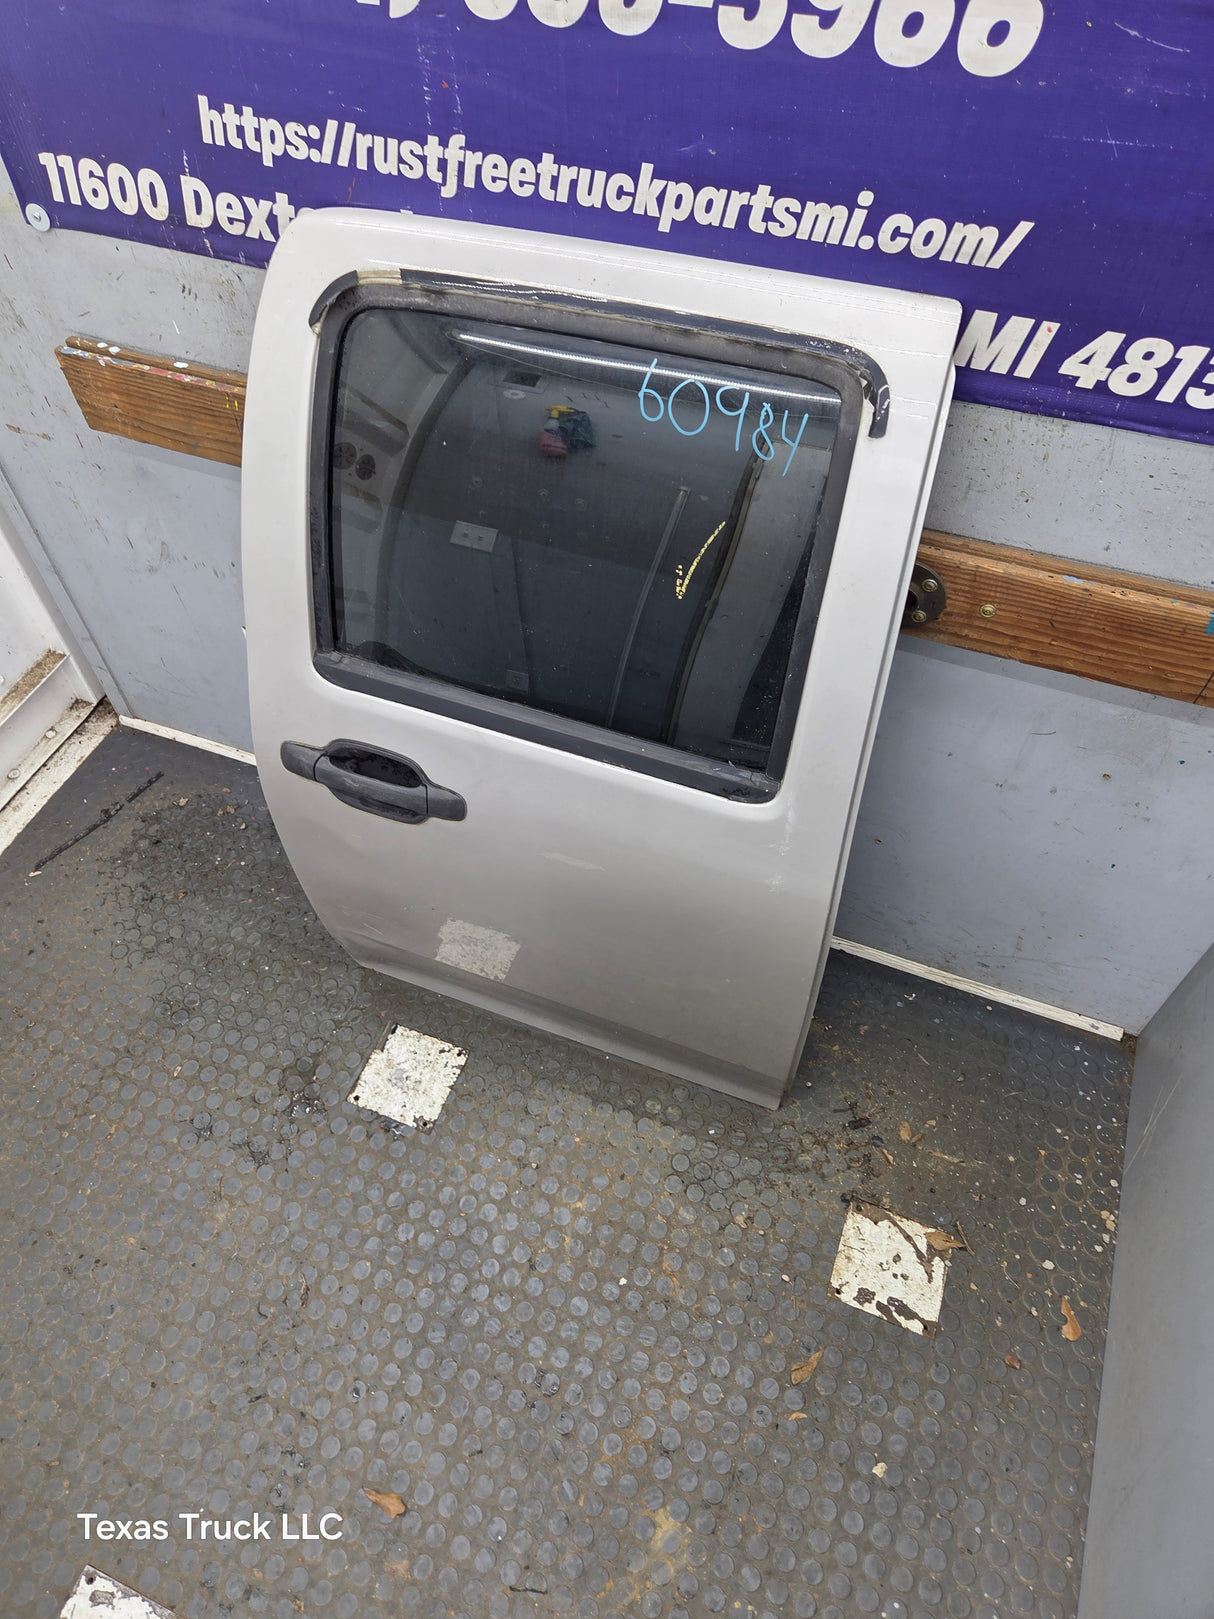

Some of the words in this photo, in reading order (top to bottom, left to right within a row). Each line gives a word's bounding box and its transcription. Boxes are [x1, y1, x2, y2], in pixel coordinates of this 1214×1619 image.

[38, 152, 169, 221] 11600
[180, 175, 315, 242] Dext
[197, 95, 1035, 269] https://rustfreetruckpartsmi.com/
[953, 310, 1061, 379] MI
[638, 358, 808, 477] 60984
